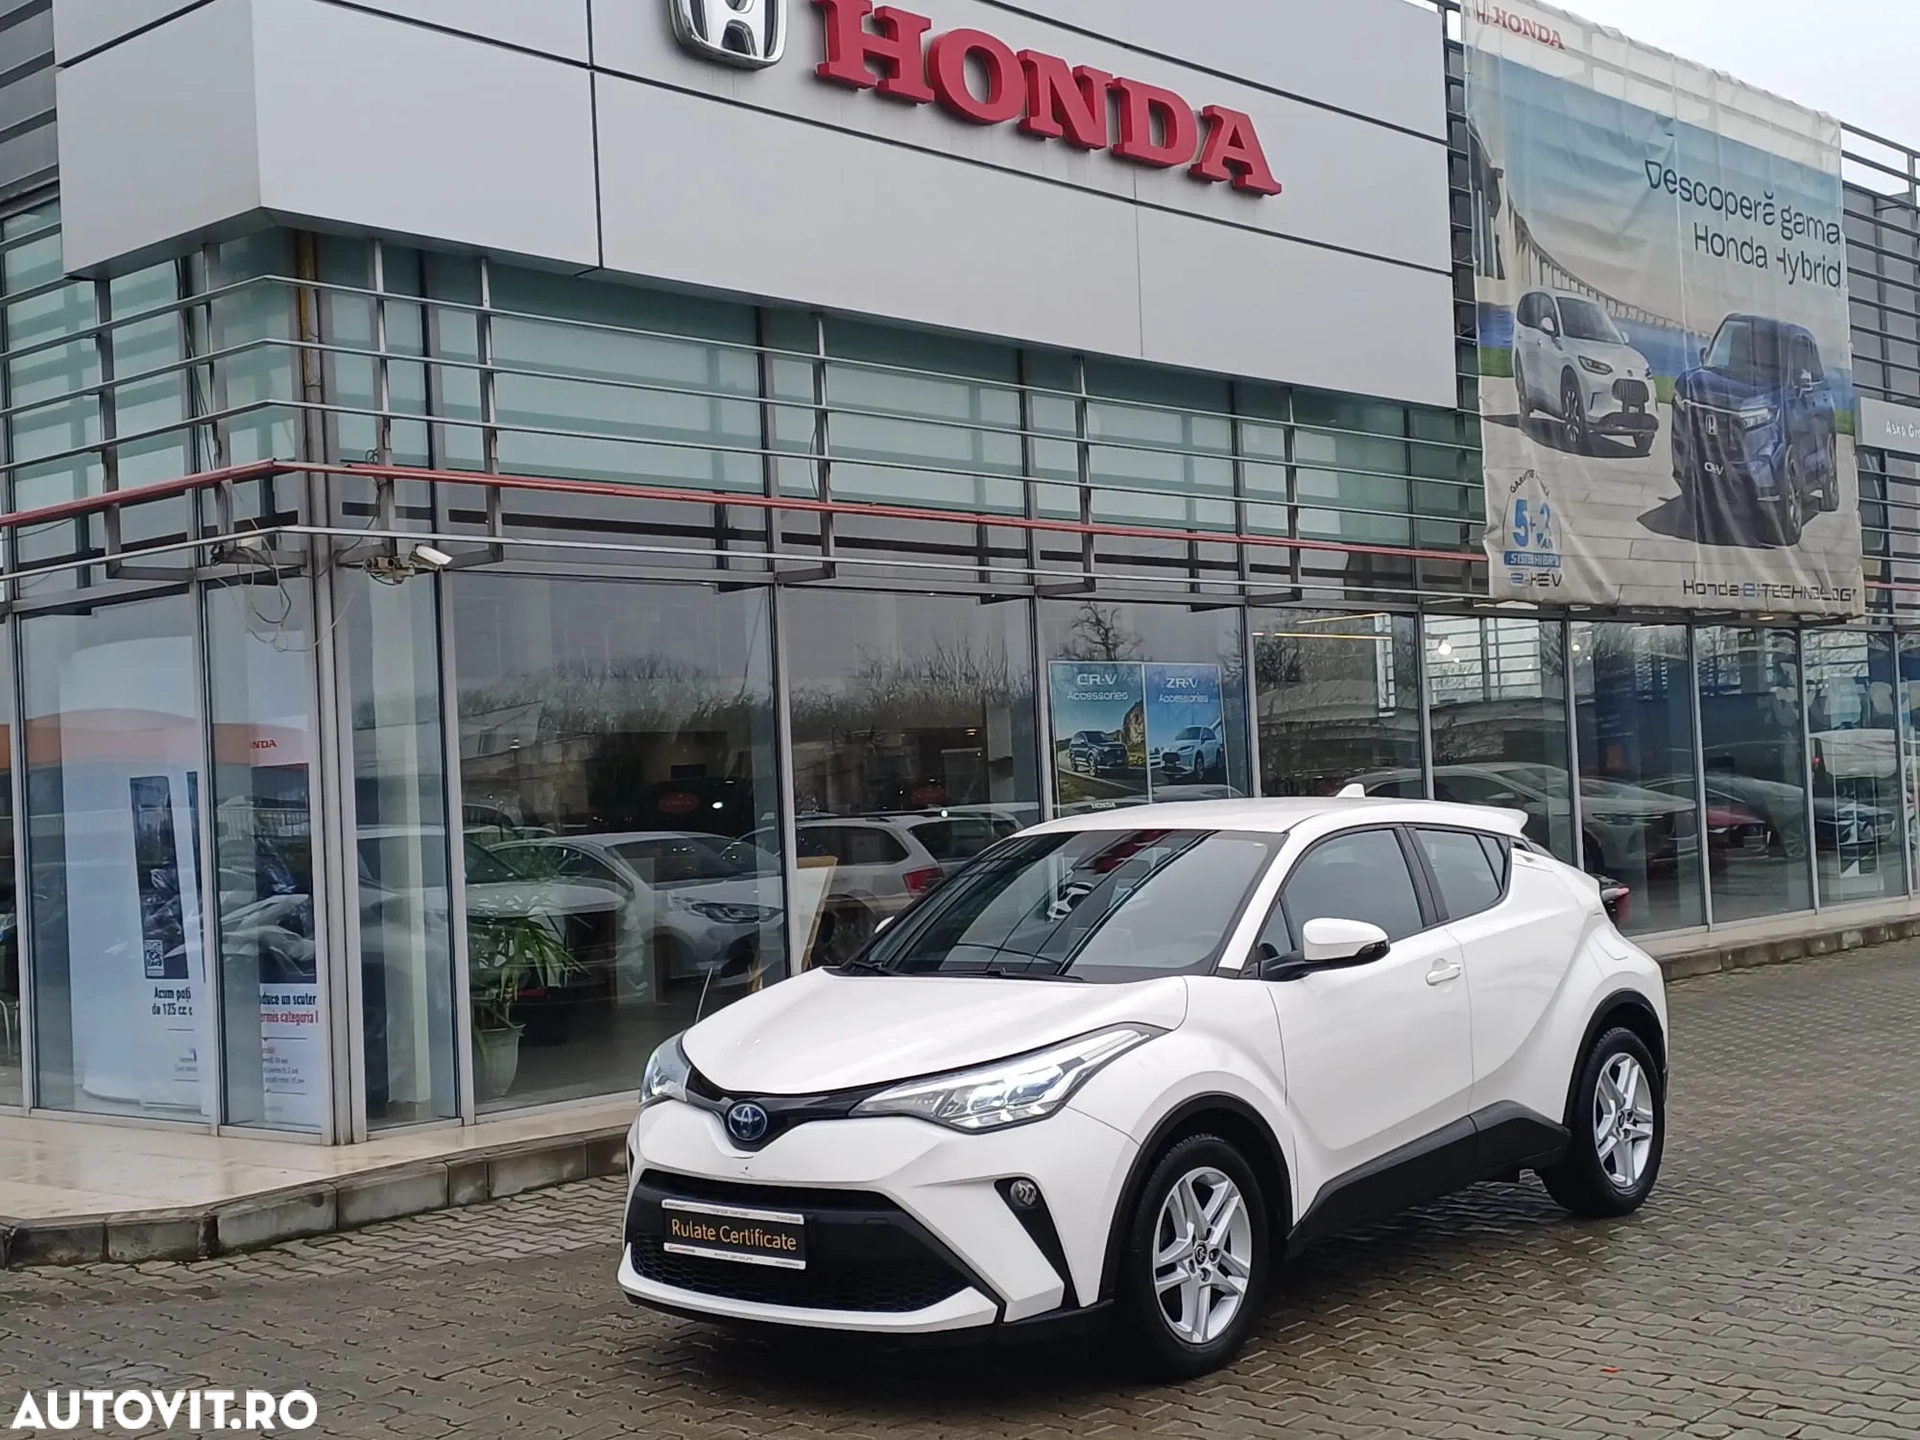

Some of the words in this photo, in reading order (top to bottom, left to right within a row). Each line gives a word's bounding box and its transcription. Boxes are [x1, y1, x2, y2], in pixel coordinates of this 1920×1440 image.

[1493, 6, 1565, 50] HONDA
[814, 0, 1282, 197] HONDA
[1645, 160, 1775, 226] Descoperă
[1780, 205, 1841, 245] gama
[1694, 222, 1768, 269] Honda
[1776, 247, 1841, 288] Hybrid
[1683, 579, 1739, 596] Honda
[1067, 690, 1128, 700] Accessories
[1158, 692, 1208, 703] Accessories
[293, 992, 317, 1006] scuter
[162, 1003, 176, 1016] 125
[280, 1011, 314, 1026] categoria
[671, 1218, 716, 1241] Rulate
[719, 1225, 797, 1251] Certificate
